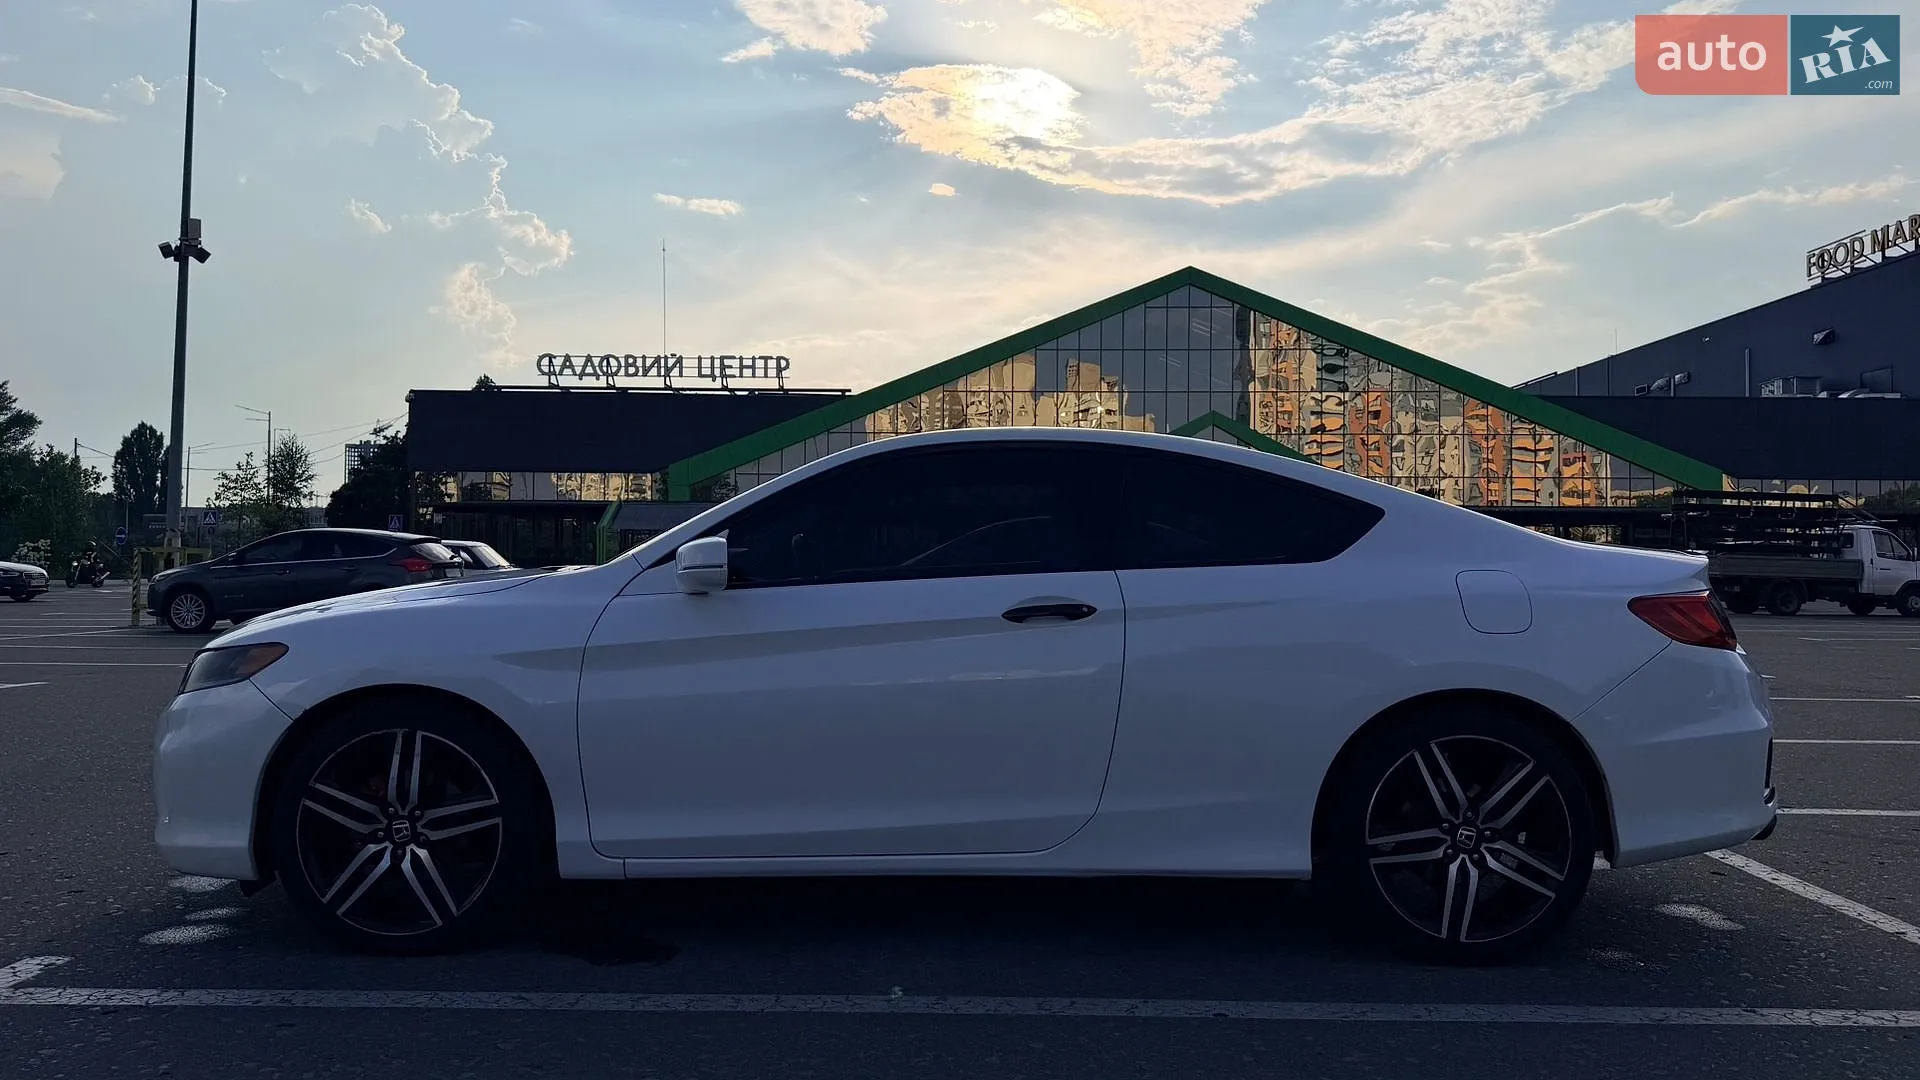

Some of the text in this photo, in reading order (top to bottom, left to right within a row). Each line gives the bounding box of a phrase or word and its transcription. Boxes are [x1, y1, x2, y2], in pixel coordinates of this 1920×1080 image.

[1806, 236, 1865, 278] FOOD
[537, 352, 790, 382] САДОВИЙ ЦЕНТР
